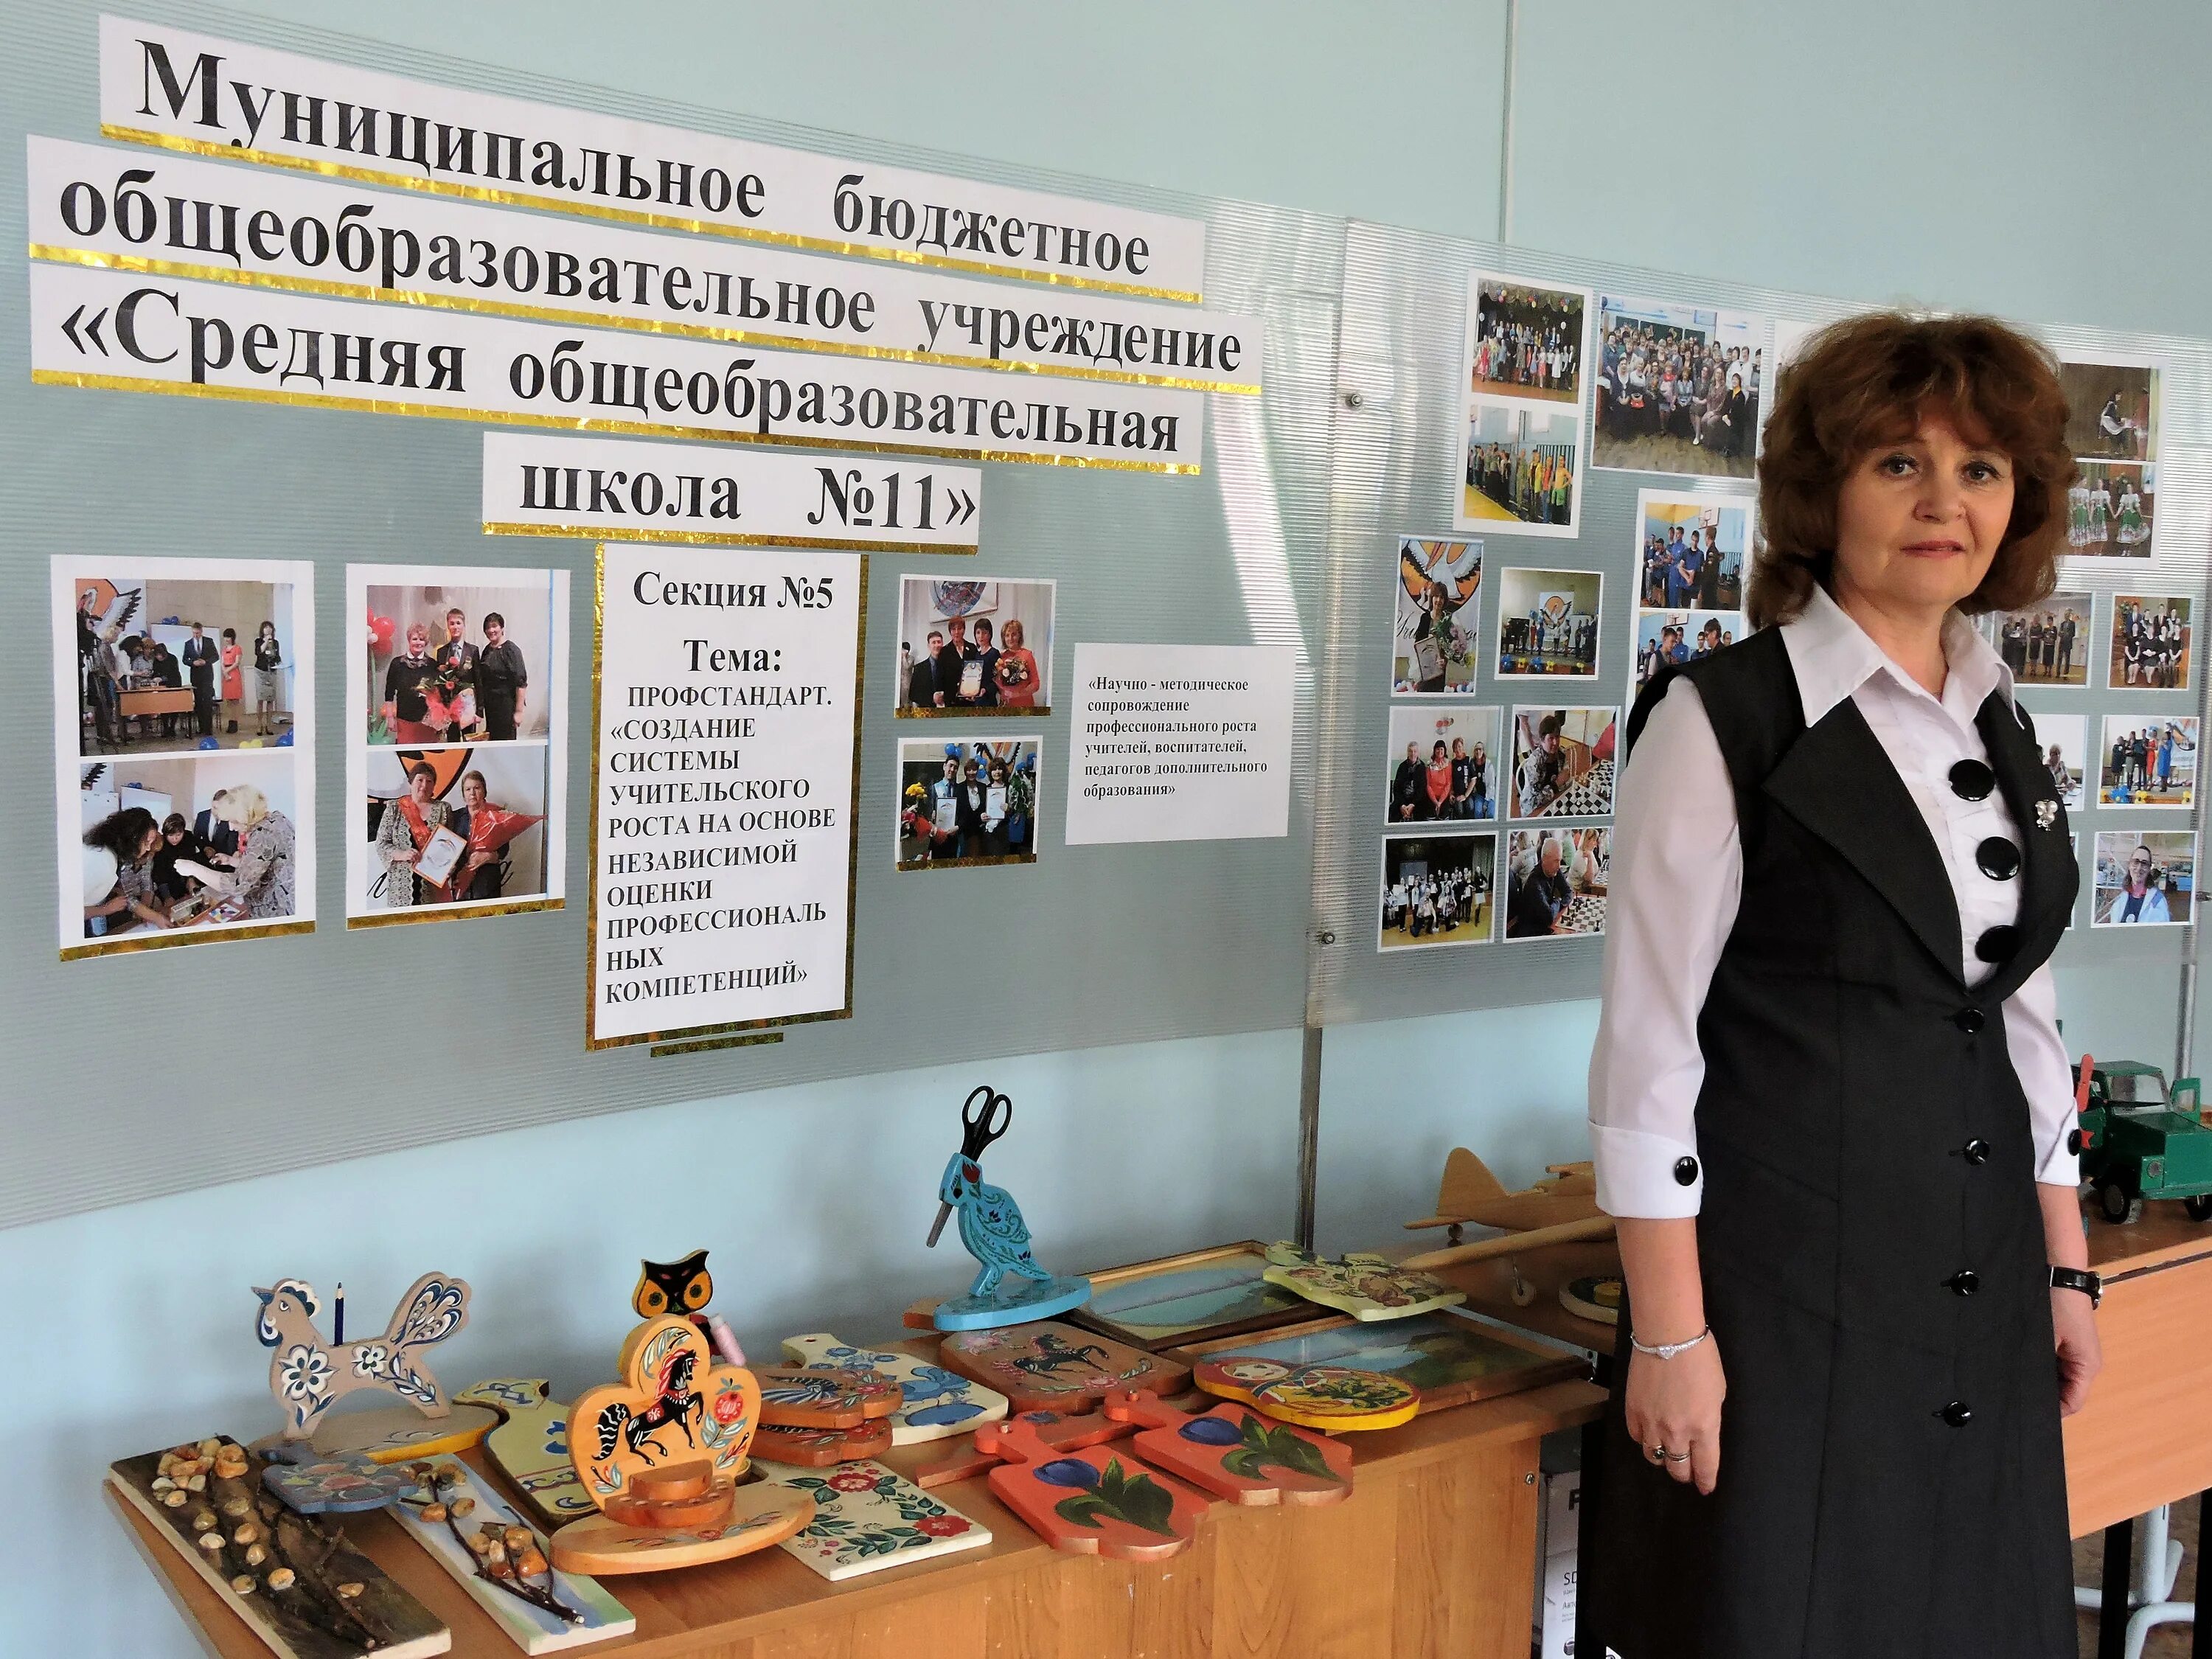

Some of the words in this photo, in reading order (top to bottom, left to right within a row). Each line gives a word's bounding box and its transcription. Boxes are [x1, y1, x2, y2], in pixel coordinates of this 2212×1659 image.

[135, 39, 765, 218] Муниципальное
[833, 174, 1150, 275] бюджетное
[60, 169, 876, 333] общеобразовательное
[917, 299, 1241, 372] учреждение
[60, 288, 467, 392] «Средняя
[509, 340, 1179, 452] общеобразовательная
[519, 465, 742, 520] школа
[807, 467, 976, 530] №11»
[633, 571, 767, 611] Секция
[776, 576, 833, 609] №5
[684, 639, 781, 672] Тема:
[628, 686, 832, 709] ПРОФСТАНДАРТ.
[1088, 676, 1147, 694] «Научно
[1160, 680, 1249, 692] методическое
[1088, 700, 1190, 715] сопровождение
[611, 718, 755, 742] «СОЗДАНИЕ
[1086, 719, 1218, 737] профессионального
[1222, 722, 1256, 736] роста
[611, 750, 739, 773] СИСТЕМЫ
[1085, 740, 1151, 758] учителей,
[1155, 739, 1247, 754] воспитателей,
[1085, 763, 1151, 777] педагогов
[1154, 762, 1268, 776] дополнительного
[610, 779, 810, 806] УЧИТЕЛЬСКОГО
[1083, 783, 1175, 801] образования»
[608, 815, 691, 838] РОСТА
[698, 813, 731, 833] НА
[739, 808, 835, 832] ОСНОВЕ
[608, 841, 797, 874] НЕЗАВИСИМОЙ
[607, 880, 712, 908] ОЦЕНКИ
[607, 902, 827, 940] ПРОФЕССИОНАЛЬ
[607, 947, 664, 972] НЫХ
[605, 962, 807, 1004] КОМПЕТЕНЦИЙ»
